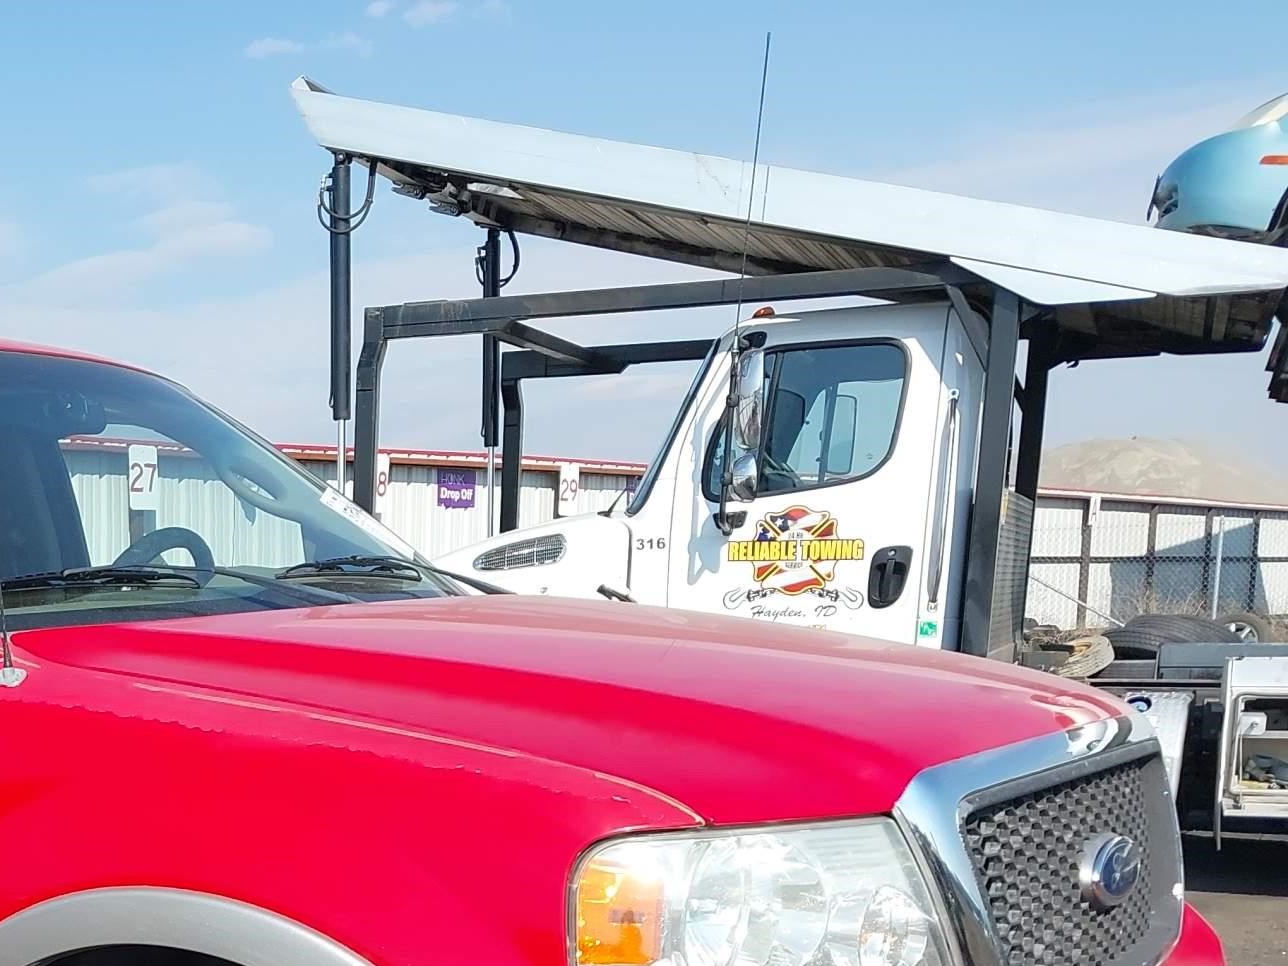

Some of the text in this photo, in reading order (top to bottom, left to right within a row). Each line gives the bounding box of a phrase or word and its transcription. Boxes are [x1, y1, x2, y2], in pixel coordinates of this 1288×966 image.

[130, 463, 156, 492] 27
[440, 487, 473, 502] Drop Off
[561, 479, 578, 501] 29
[636, 537, 666, 550] 316
[728, 539, 864, 561] RELIABLE TOWING
[750, 605, 837, 622] Hayden, ID
